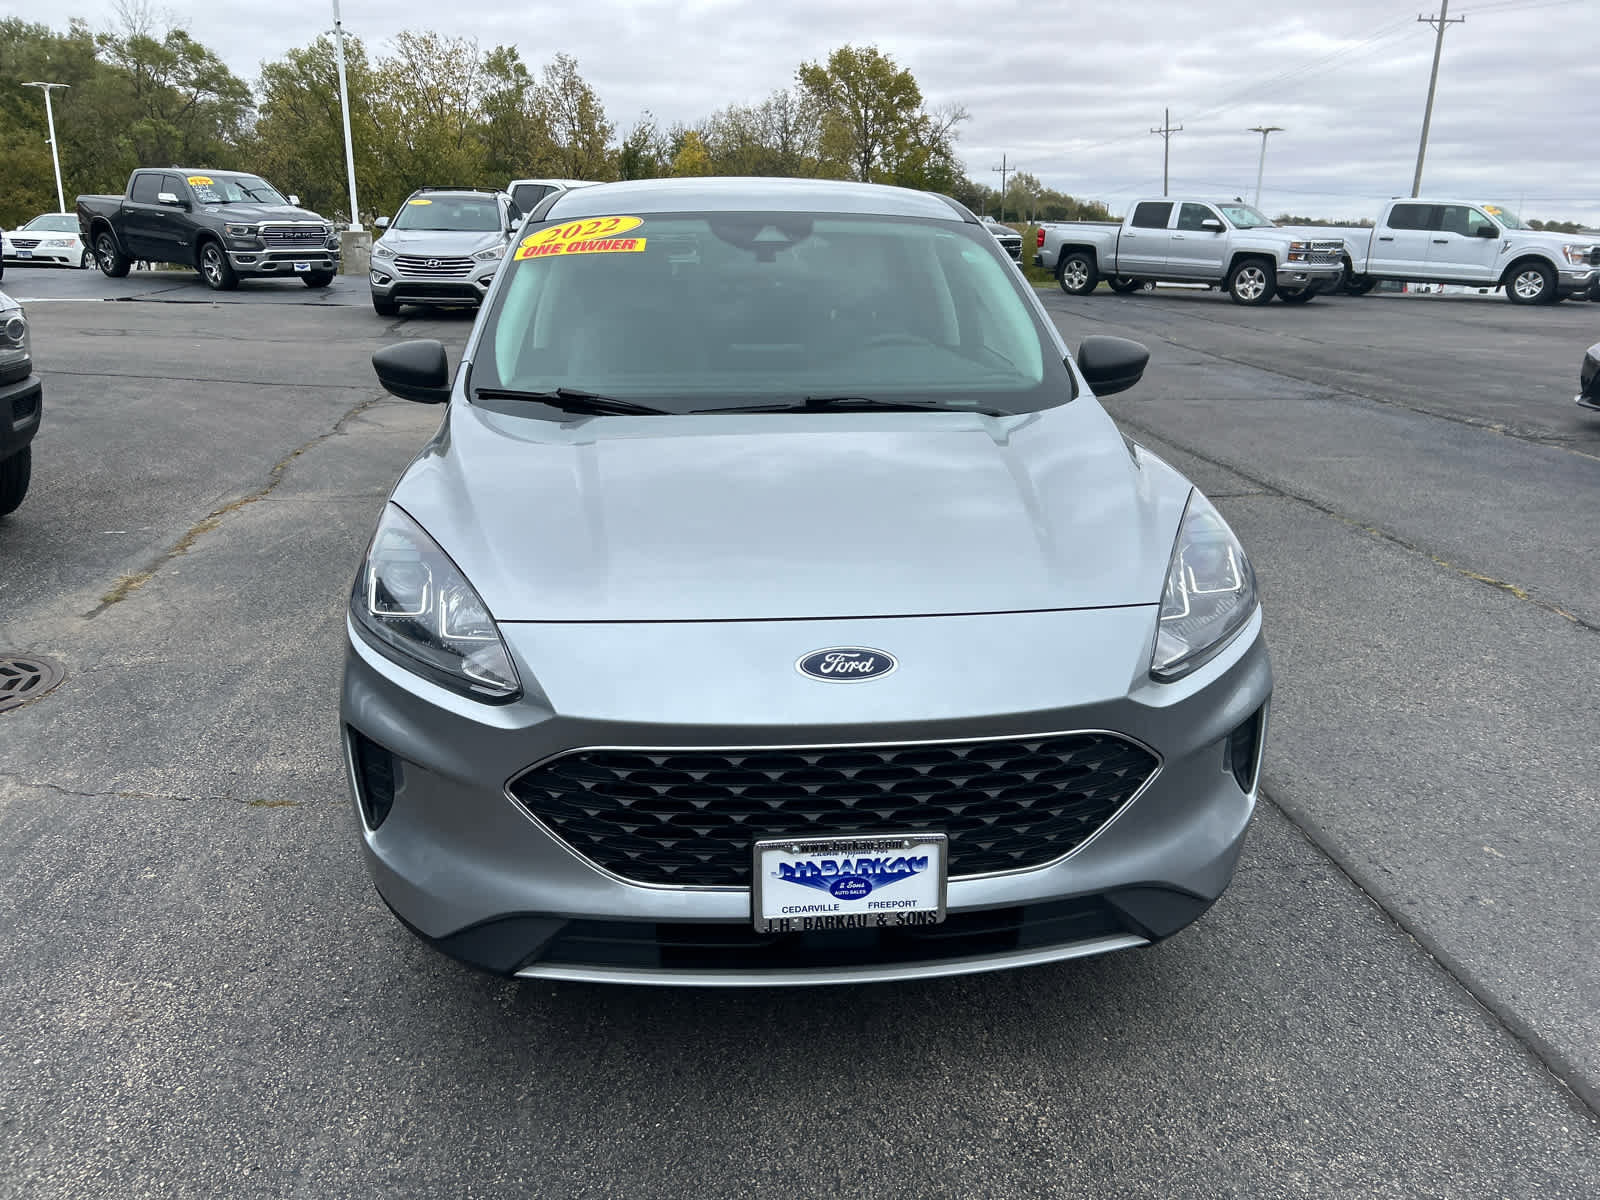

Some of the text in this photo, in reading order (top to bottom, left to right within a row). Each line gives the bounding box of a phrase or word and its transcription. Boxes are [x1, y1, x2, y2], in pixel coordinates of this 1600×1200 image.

[541, 218, 621, 243] 2022
[522, 239, 637, 257] ONE OWNER
[820, 653, 875, 674] Ford
[800, 840, 902, 853] www.barkau.com
[846, 881, 865, 889] Sons
[781, 900, 918, 914] CEDARVILLE FREEPORT
[764, 911, 937, 933] J.H. BARKAU & SONS
